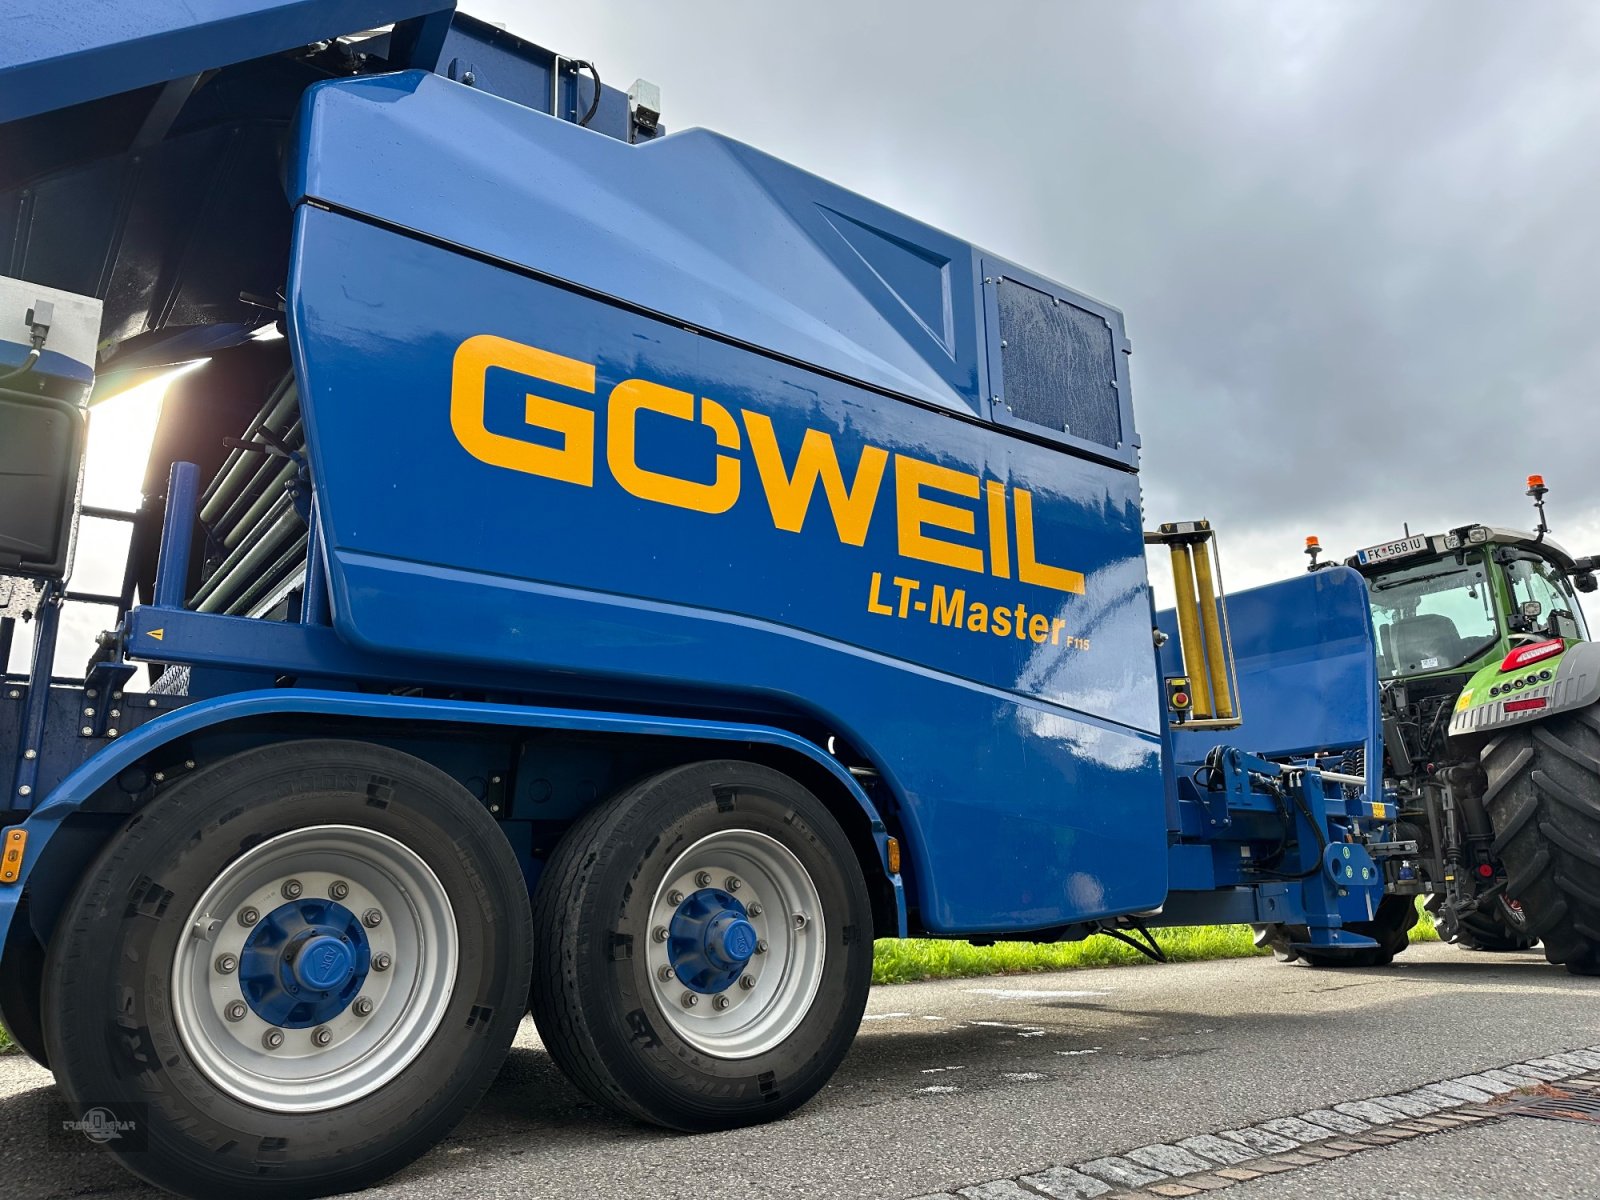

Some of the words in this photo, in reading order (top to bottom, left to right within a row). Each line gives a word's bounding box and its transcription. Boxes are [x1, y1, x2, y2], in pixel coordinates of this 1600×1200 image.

[1368, 547, 1382, 560] FK
[1387, 541, 1408, 555] 568
[1409, 538, 1421, 550] IU
[867, 572, 1066, 646] LT-Master
[1066, 635, 1091, 651] F115
[320, 945, 337, 970] ADR
